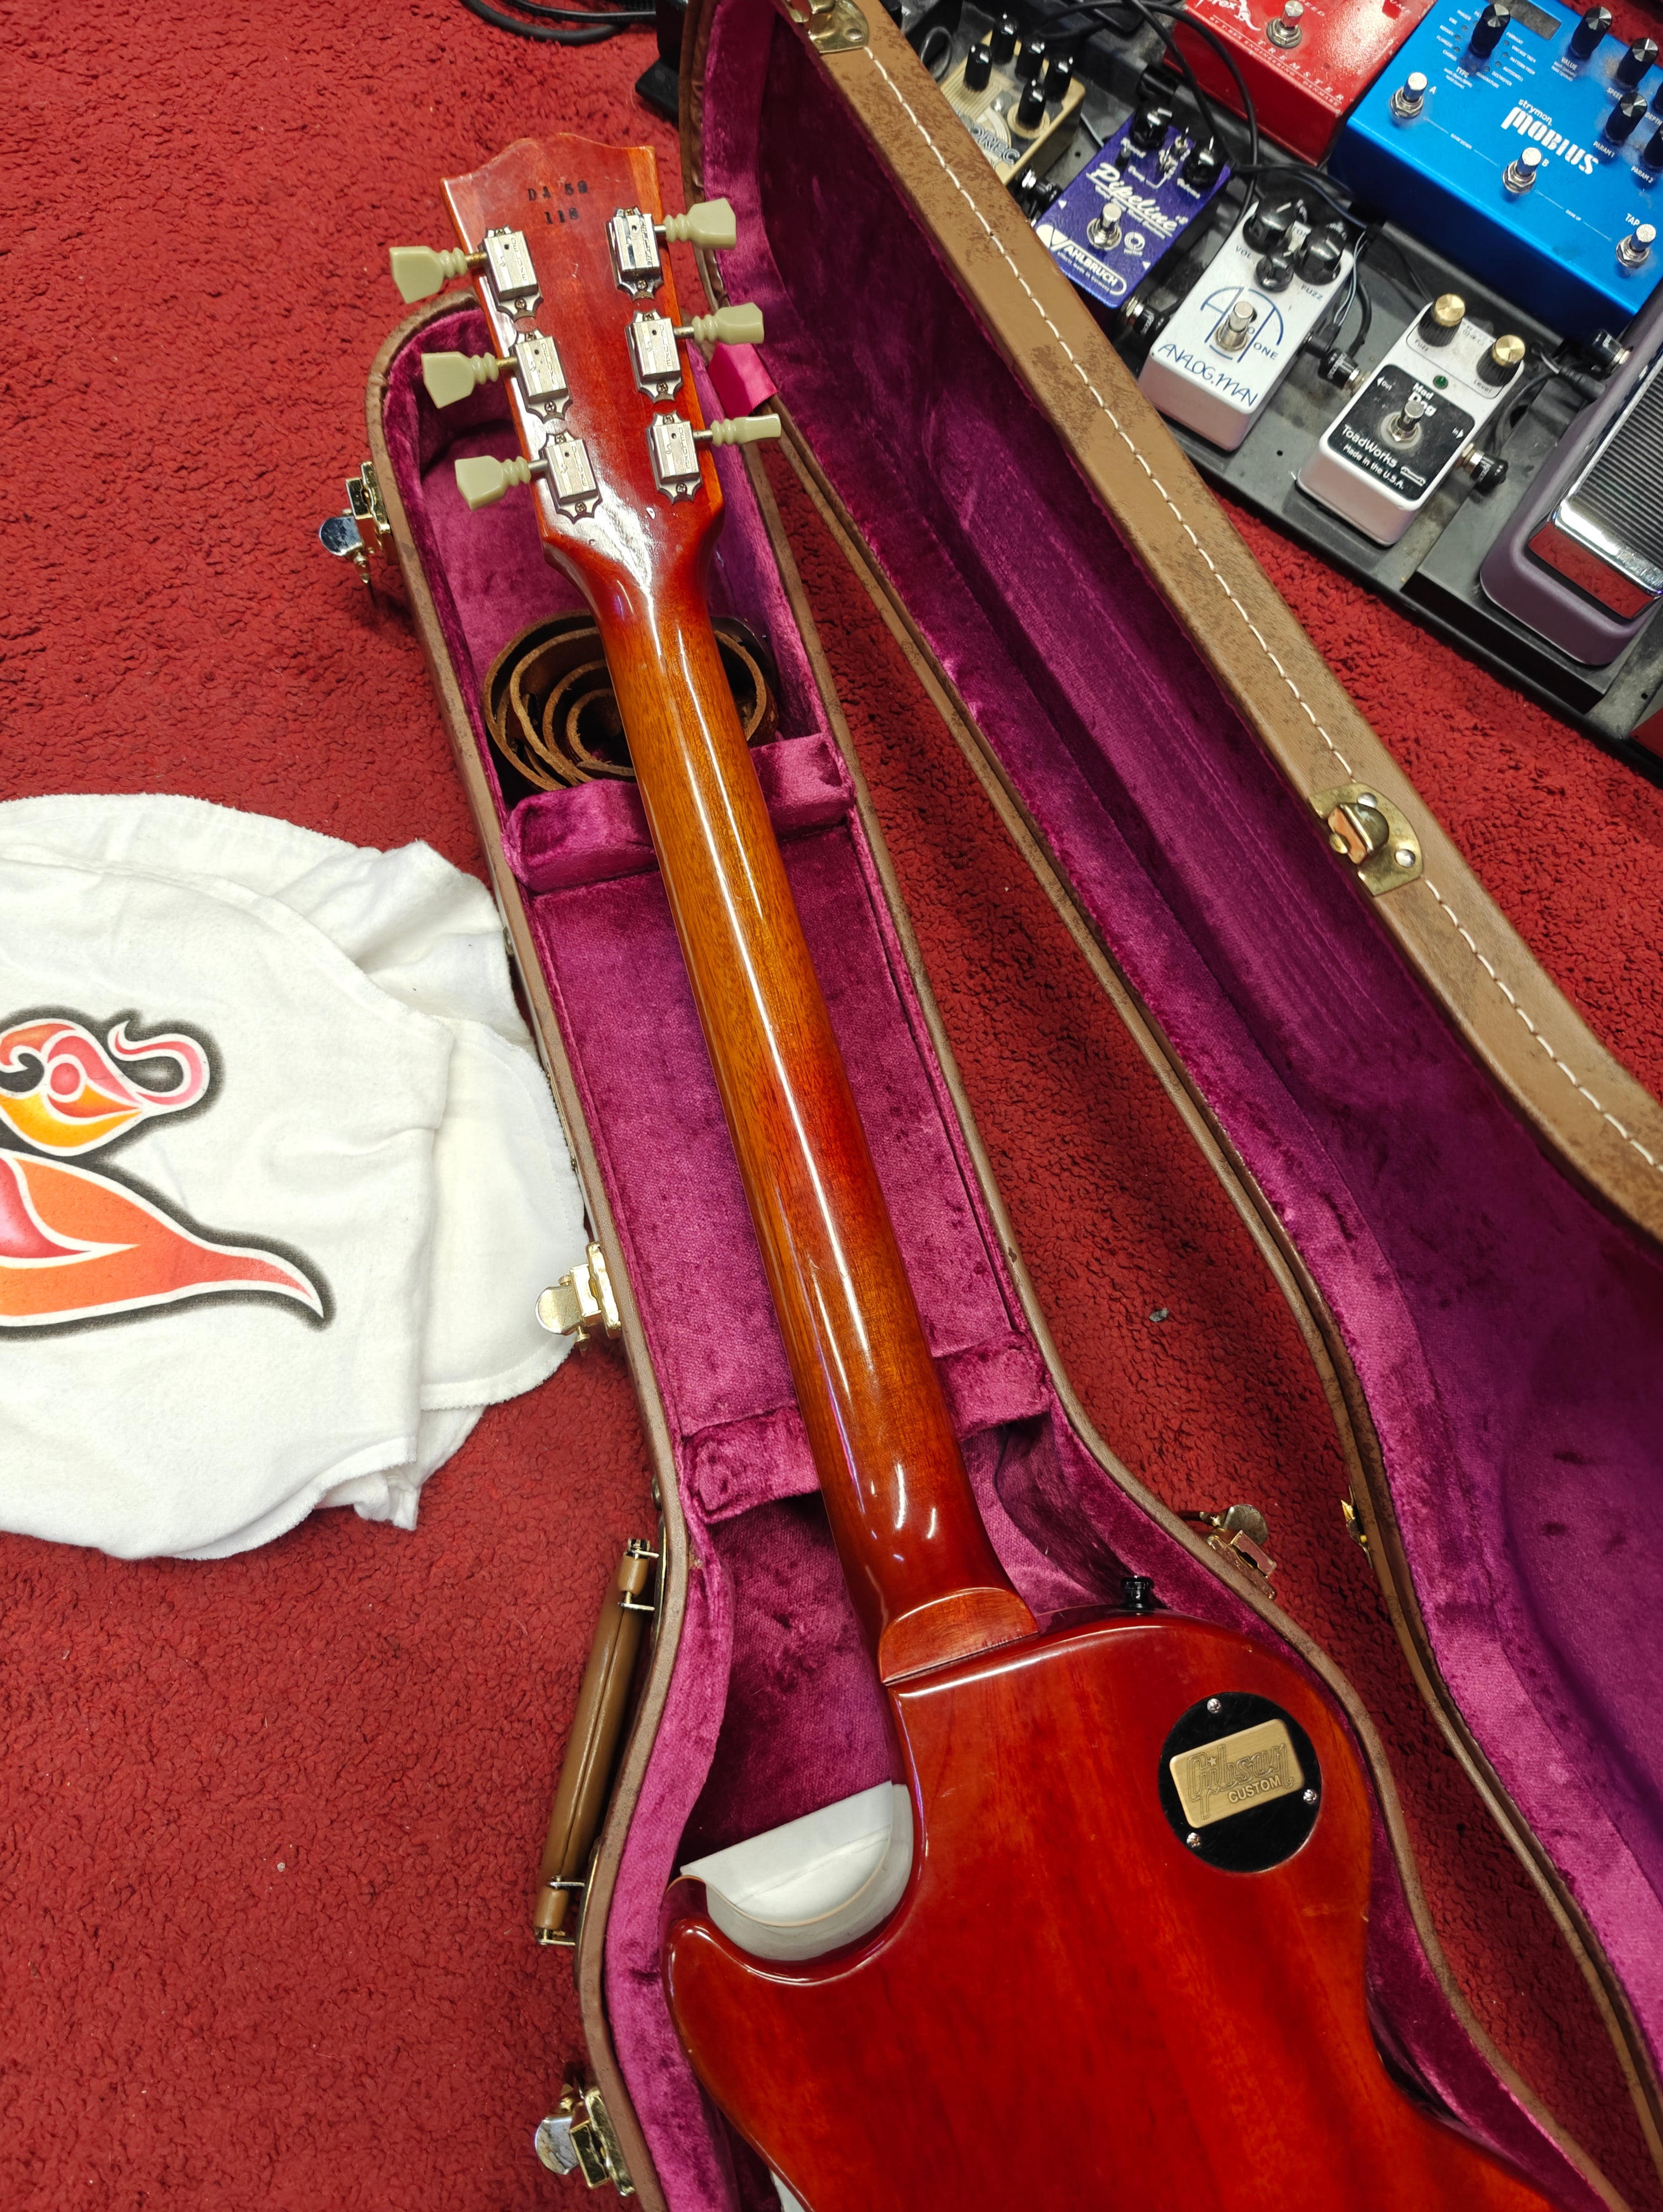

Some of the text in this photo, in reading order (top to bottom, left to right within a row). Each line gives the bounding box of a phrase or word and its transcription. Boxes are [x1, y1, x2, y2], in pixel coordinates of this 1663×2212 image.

[1561, 56, 1578, 71] VALUE
[1456, 66, 1470, 79] TYPE
[1429, 85, 1437, 95] A
[1593, 140, 1612, 156] PARAM
[1541, 158, 1549, 168] B
[1630, 165, 1650, 181] PARAM
[1624, 212, 1641, 227] TAP
[1235, 246, 1252, 259] VOL
[1300, 284, 1324, 301] FUZZ
[1412, 382, 1434, 400] Mad
[1342, 424, 1398, 468] ToadWorks
[1343, 444, 1362, 460] Made
[1370, 460, 1383, 474] the
[1383, 470, 1404, 490] U.S.A.
[1228, 1775, 1282, 1803] CUSTOM
